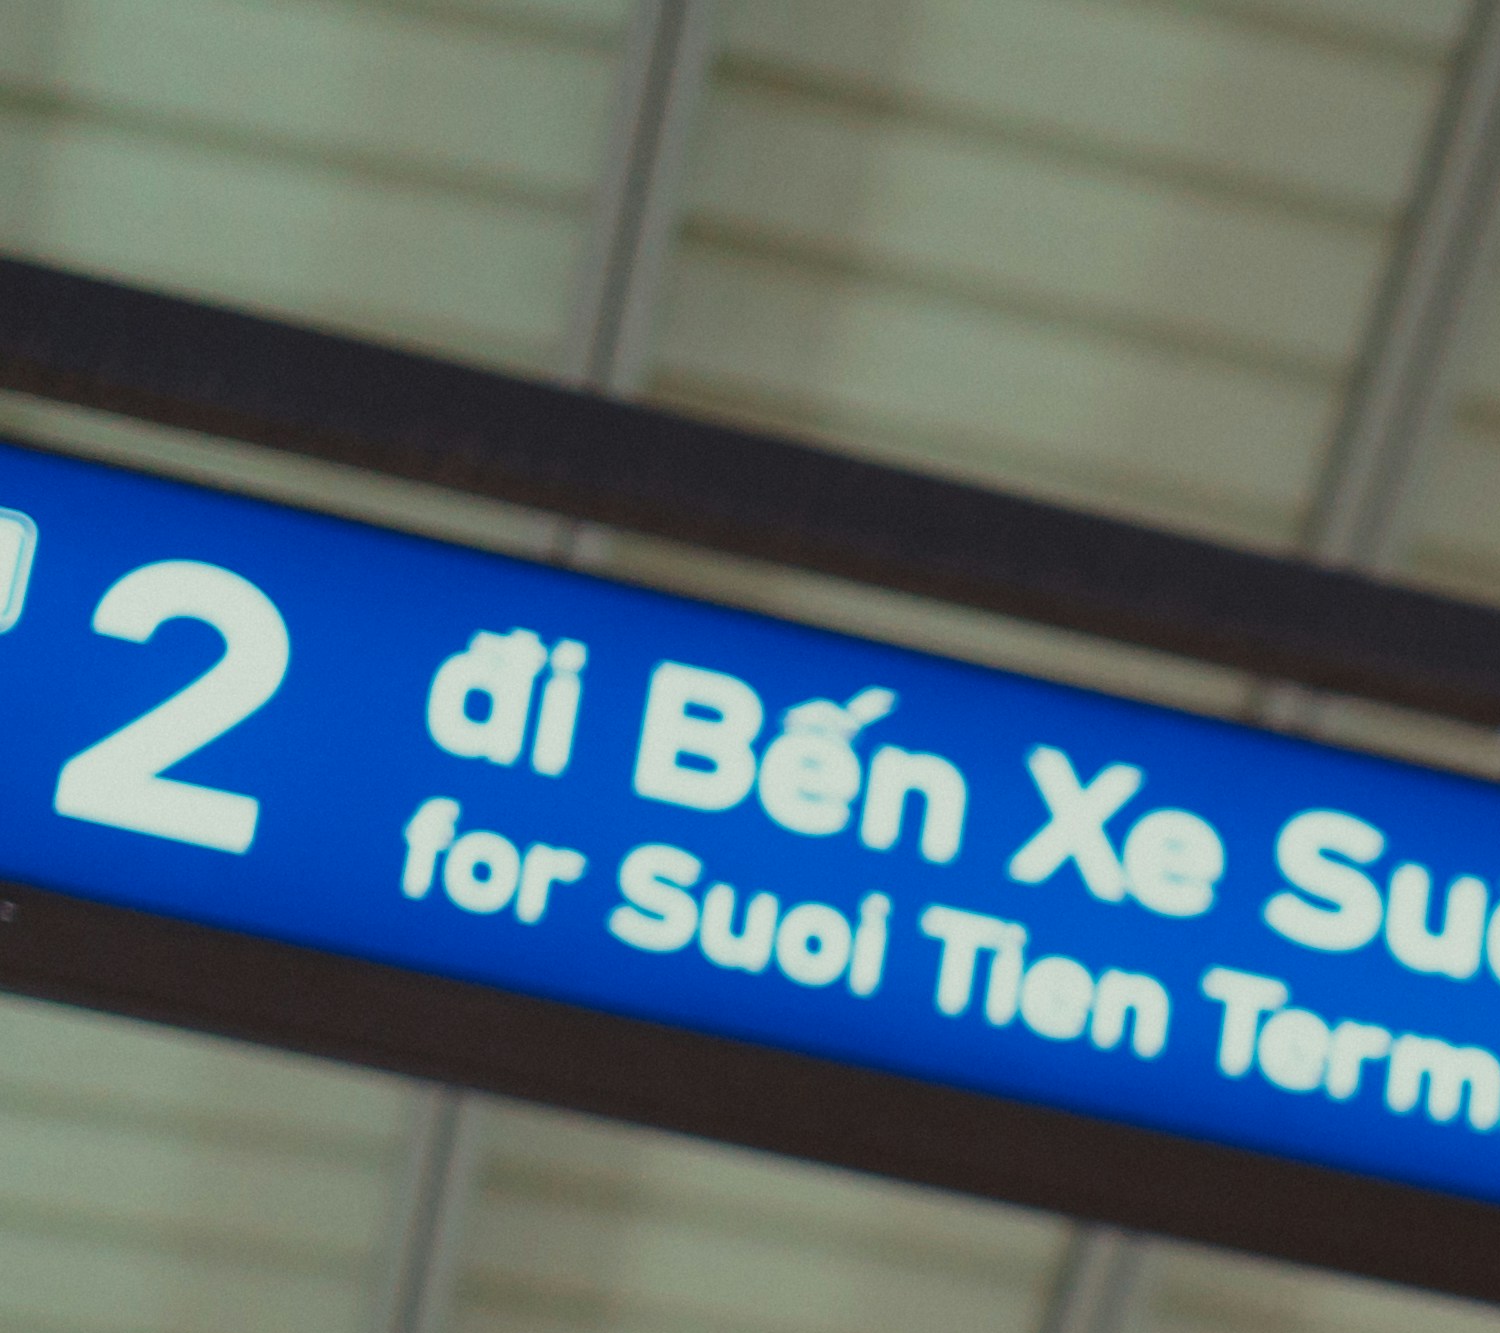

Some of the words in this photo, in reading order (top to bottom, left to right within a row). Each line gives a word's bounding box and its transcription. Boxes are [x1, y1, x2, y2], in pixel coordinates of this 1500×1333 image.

[54, 560, 290, 855] 2
[427, 629, 587, 776] đi
[634, 661, 967, 863] Bến
[1009, 747, 1224, 917] Xe
[403, 797, 586, 923] for
[610, 844, 891, 995] Suoi
[920, 905, 1170, 1058] Tien
